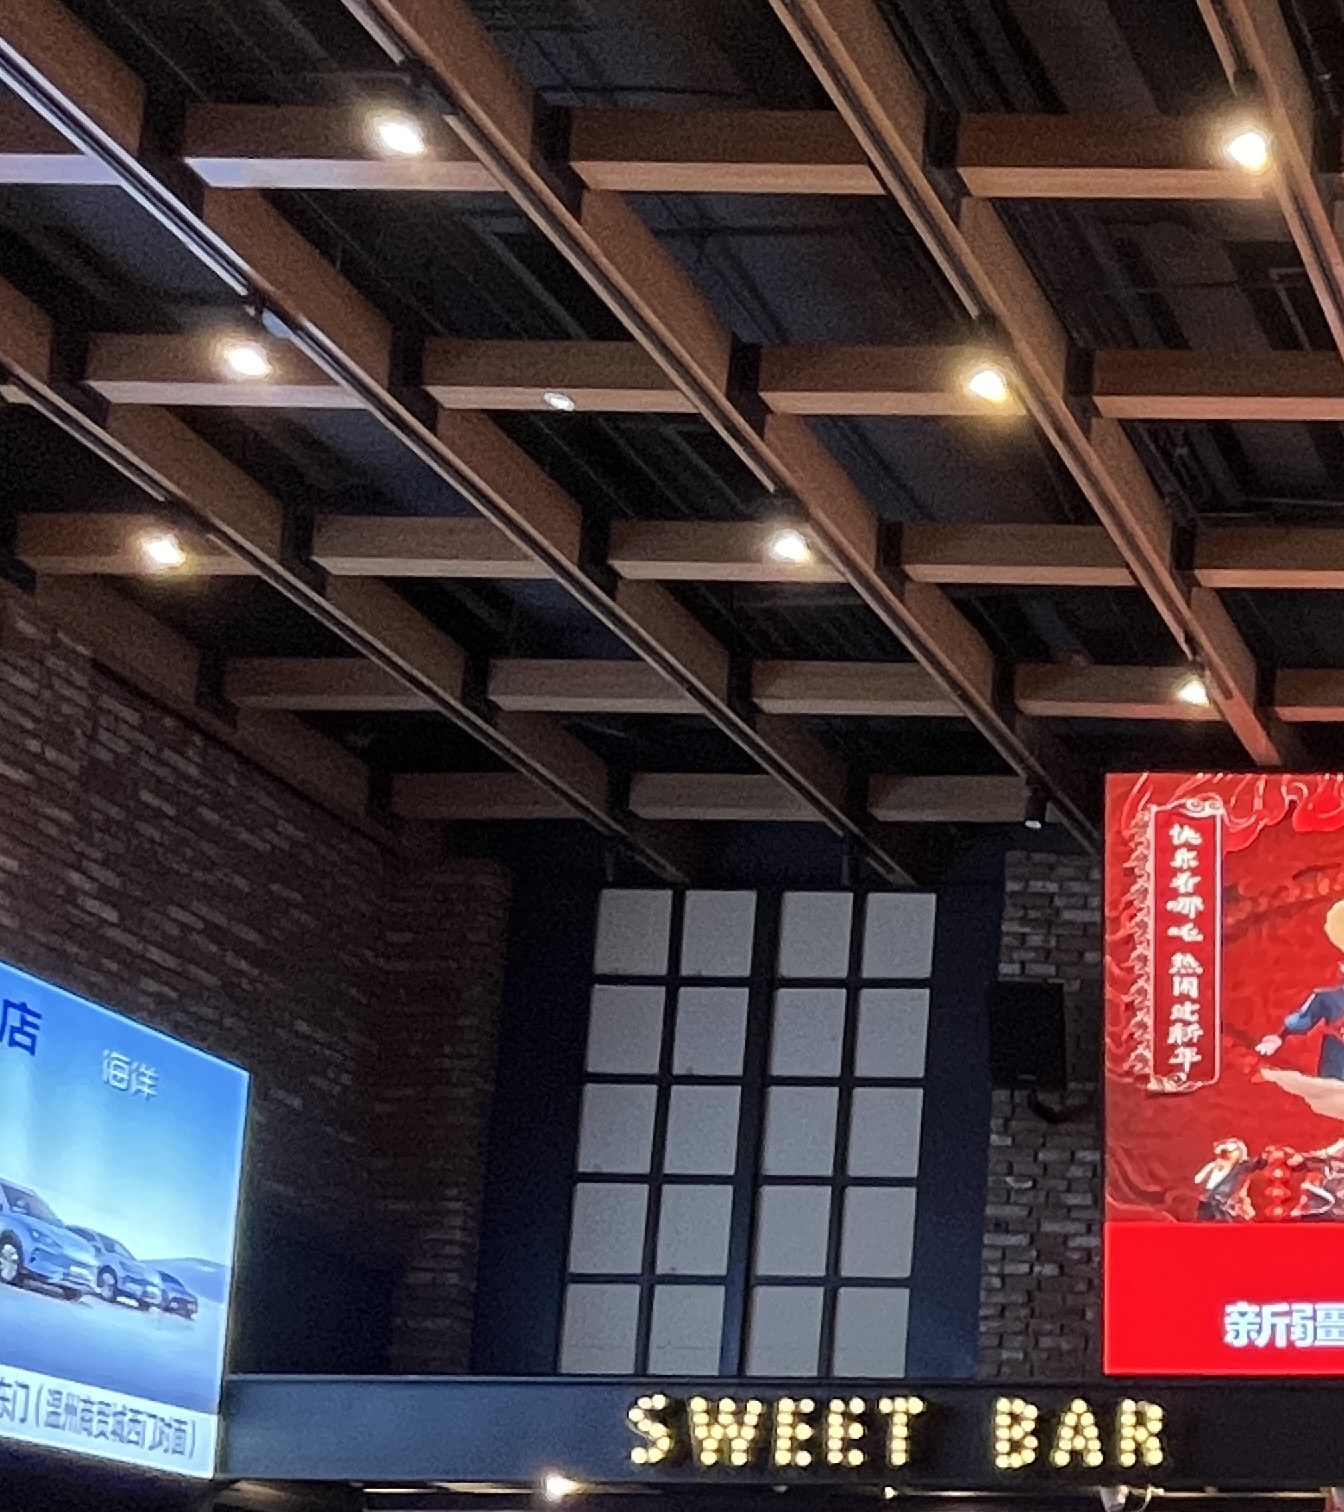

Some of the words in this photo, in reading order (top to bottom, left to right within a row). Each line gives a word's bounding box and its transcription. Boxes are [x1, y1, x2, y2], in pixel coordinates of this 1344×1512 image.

[0, 999, 42, 1057] 店
[626, 1393, 925, 1467] SWEET
[994, 1397, 1166, 1469] BAR
